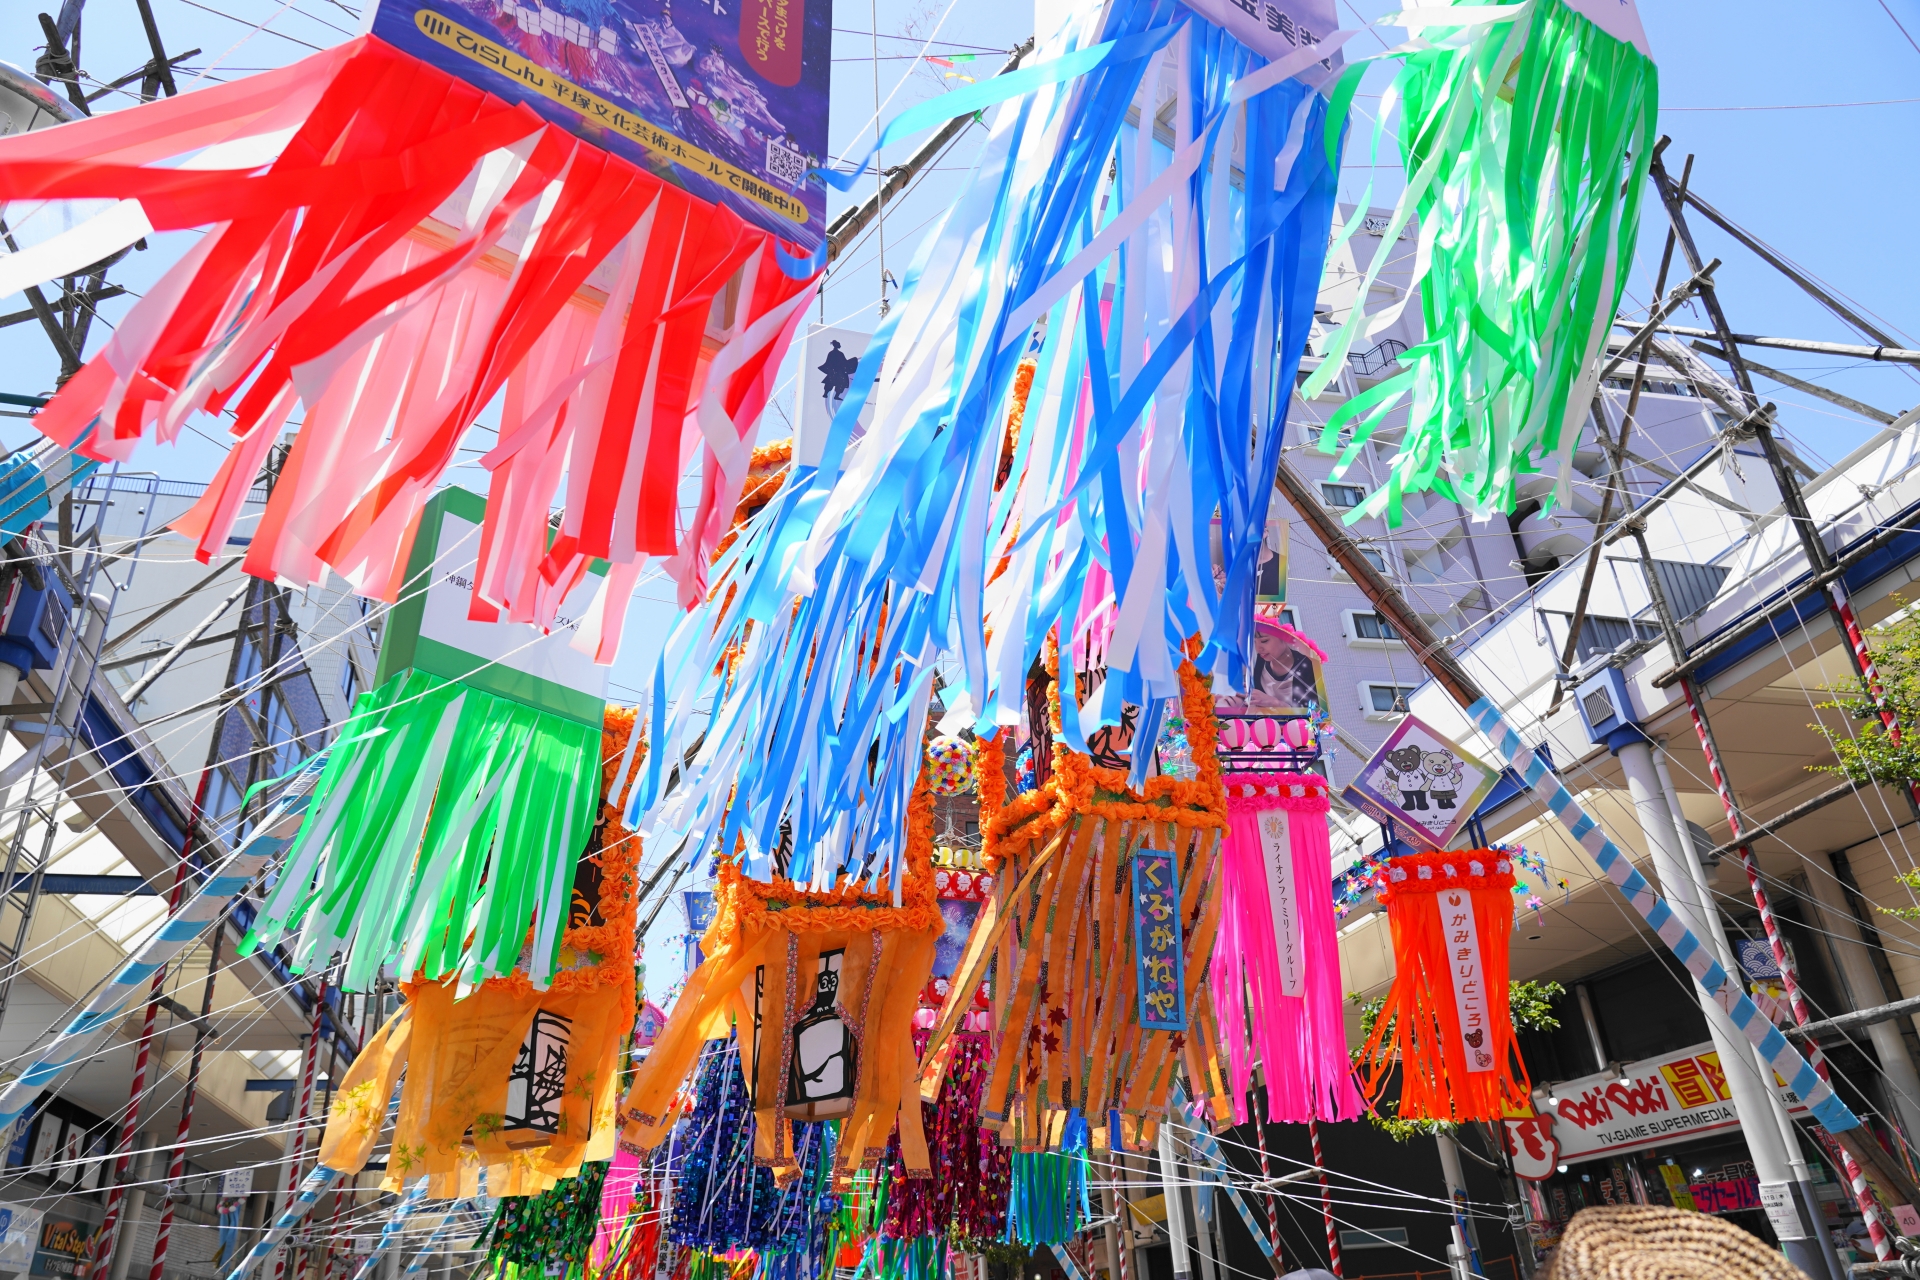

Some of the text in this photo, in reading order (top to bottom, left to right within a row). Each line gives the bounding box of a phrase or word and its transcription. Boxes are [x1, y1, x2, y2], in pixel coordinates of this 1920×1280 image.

[456, 32, 544, 87] ひらしん
[551, 79, 801, 218] 平塚文化芸術ホールで開催中!!
[446, 572, 473, 590] 神鋼タ
[1145, 861, 1175, 1018] くろがねや
[1273, 843, 1297, 990] ライオンファミリーグループ
[1451, 913, 1481, 1027] かみきりどころ
[1597, 1106, 1734, 1146] TV-GAME SUPERMEDIA
[43, 1224, 66, 1251] Vital
[1903, 1217, 1916, 1226] 40
